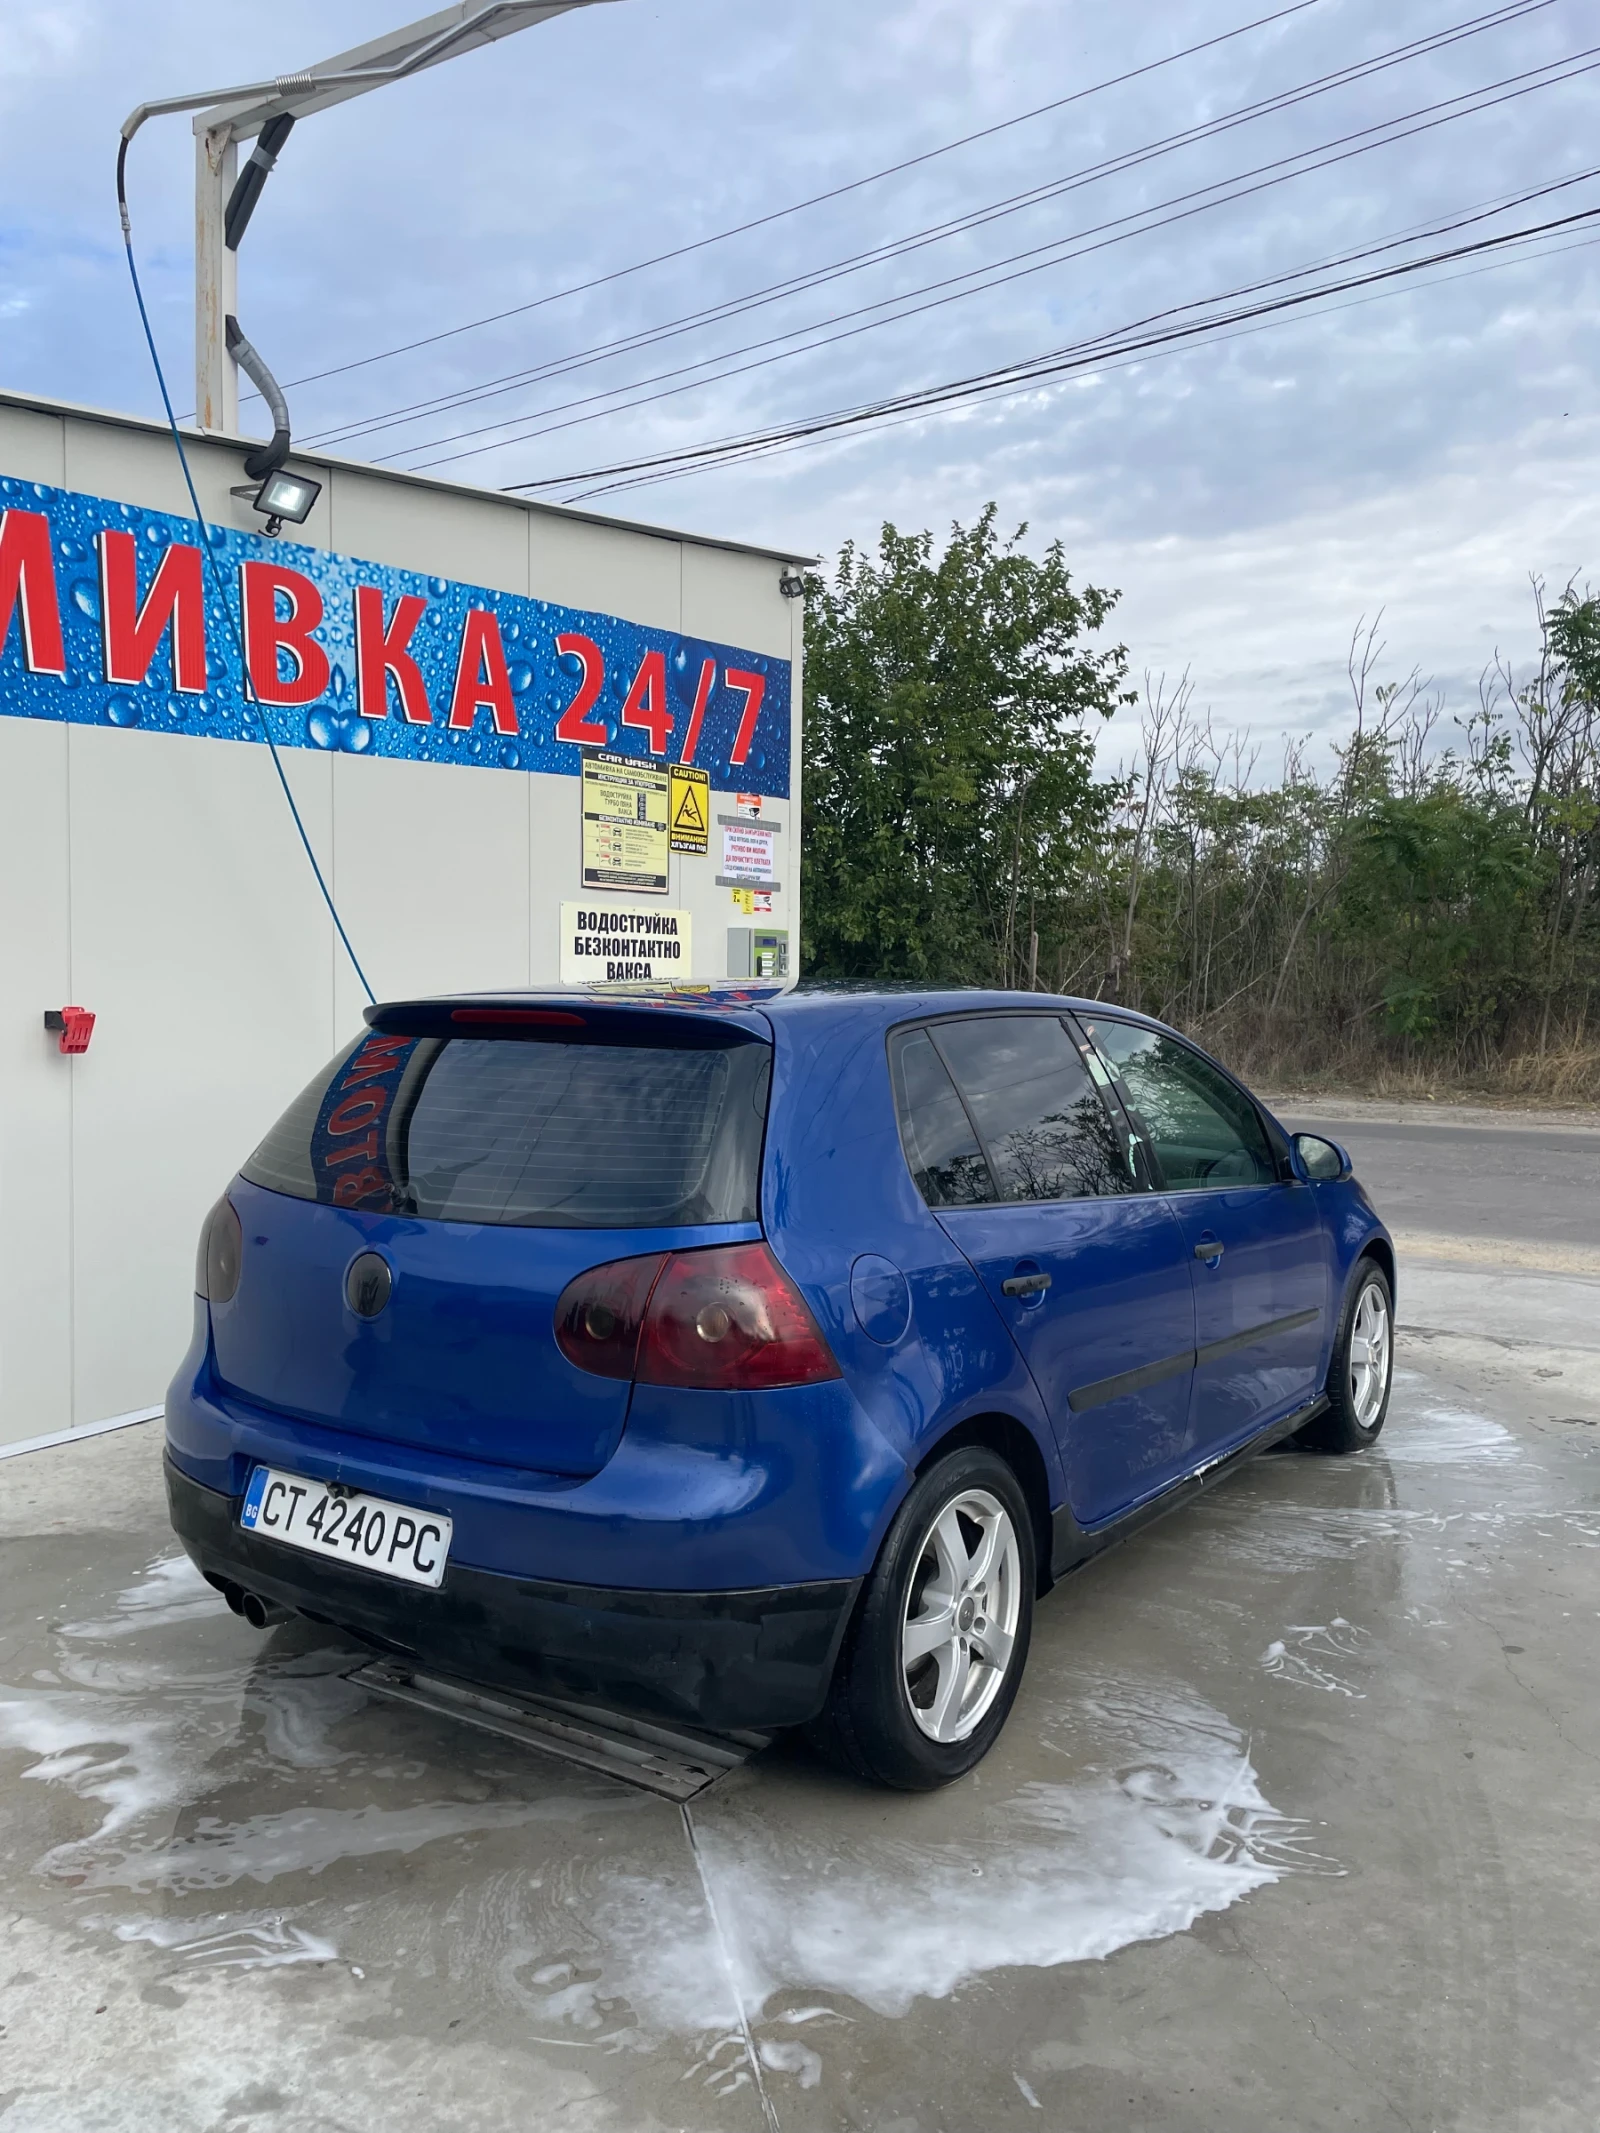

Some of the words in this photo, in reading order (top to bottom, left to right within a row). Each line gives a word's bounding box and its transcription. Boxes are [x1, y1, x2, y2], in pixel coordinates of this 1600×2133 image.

[555, 633, 766, 765] 24/7
[598, 753, 622, 763] CAR
[625, 758, 657, 770] WASH
[673, 768, 706, 781] CAUTION!
[696, 844, 706, 853] ПОД
[577, 911, 678, 935] ВОДОСТРУЙКА
[574, 937, 681, 959] БЕЗКОНТАКТНО
[607, 962, 652, 980] ВАКСА
[245, 1503, 259, 1519] BG
[262, 1481, 307, 1531] CT
[306, 1495, 386, 1556] 4240
[387, 1516, 441, 1573] PC
